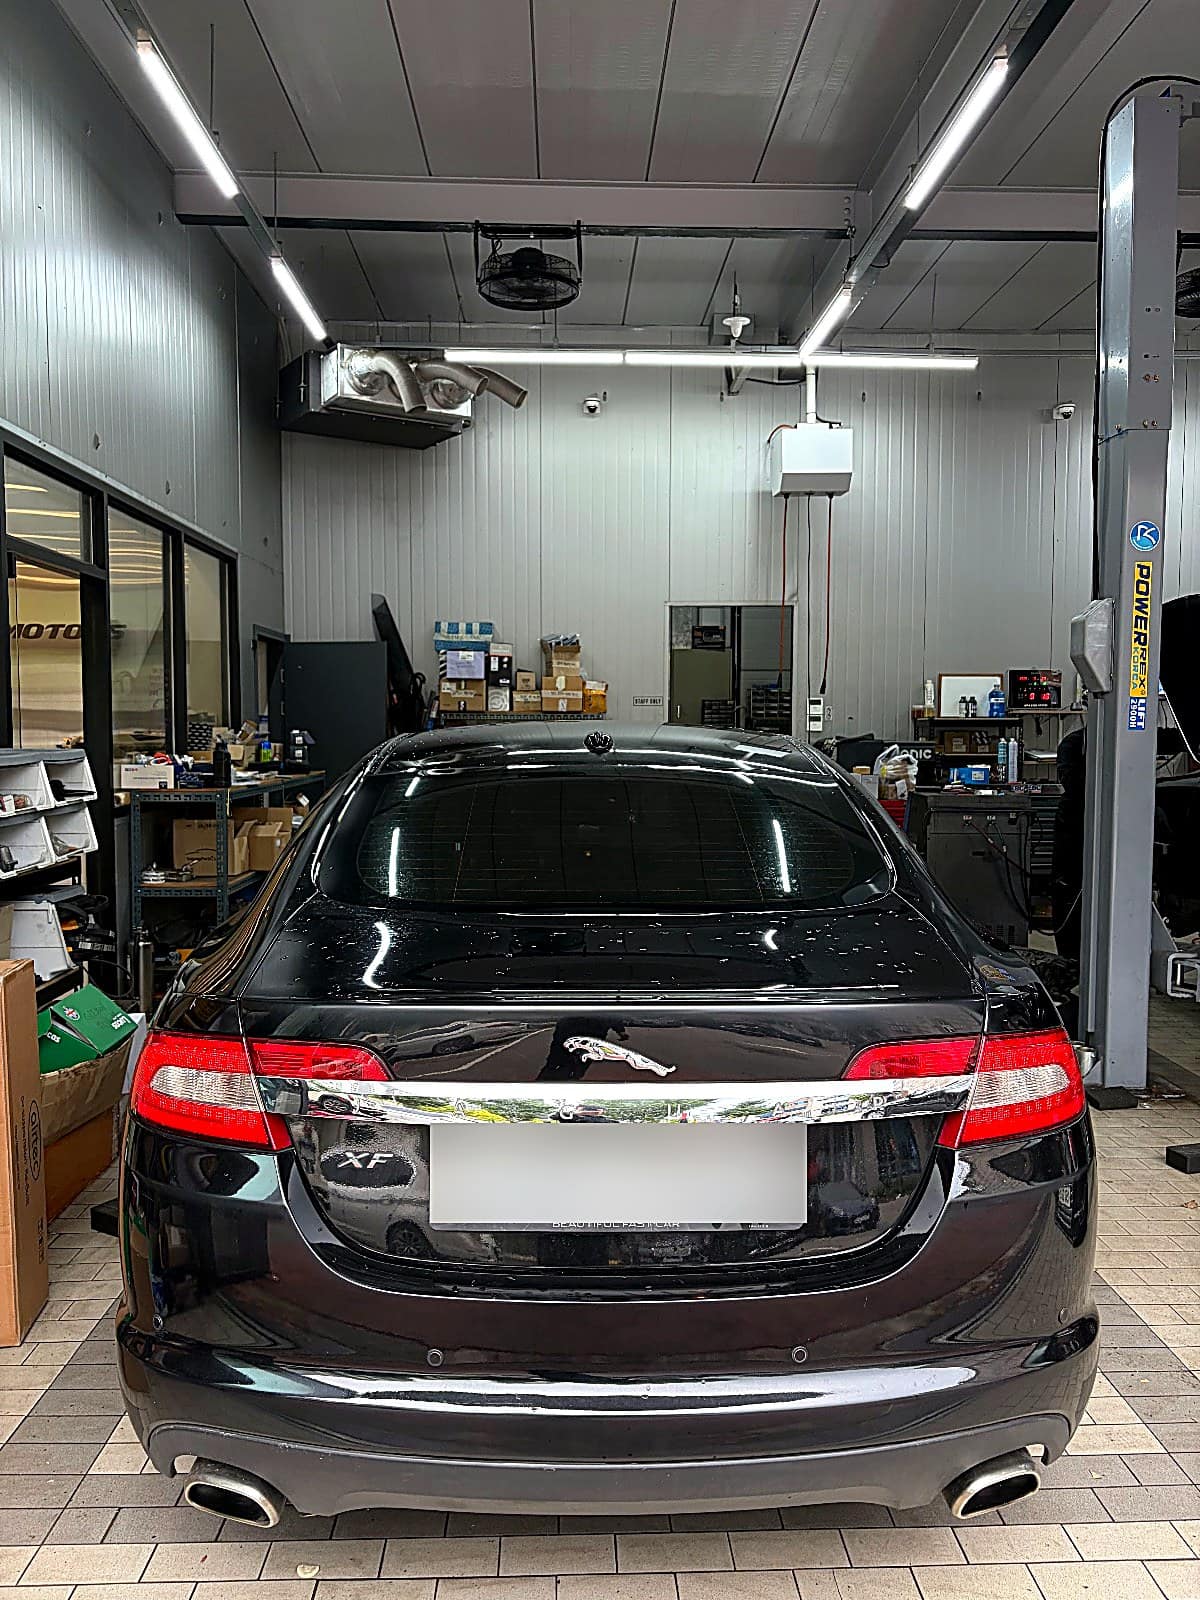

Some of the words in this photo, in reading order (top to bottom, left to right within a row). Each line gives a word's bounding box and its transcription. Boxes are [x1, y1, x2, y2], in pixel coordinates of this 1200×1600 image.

[9, 622, 127, 640] MOTOS
[1138, 698, 1146, 729] LIFT
[337, 1152, 394, 1169] XF
